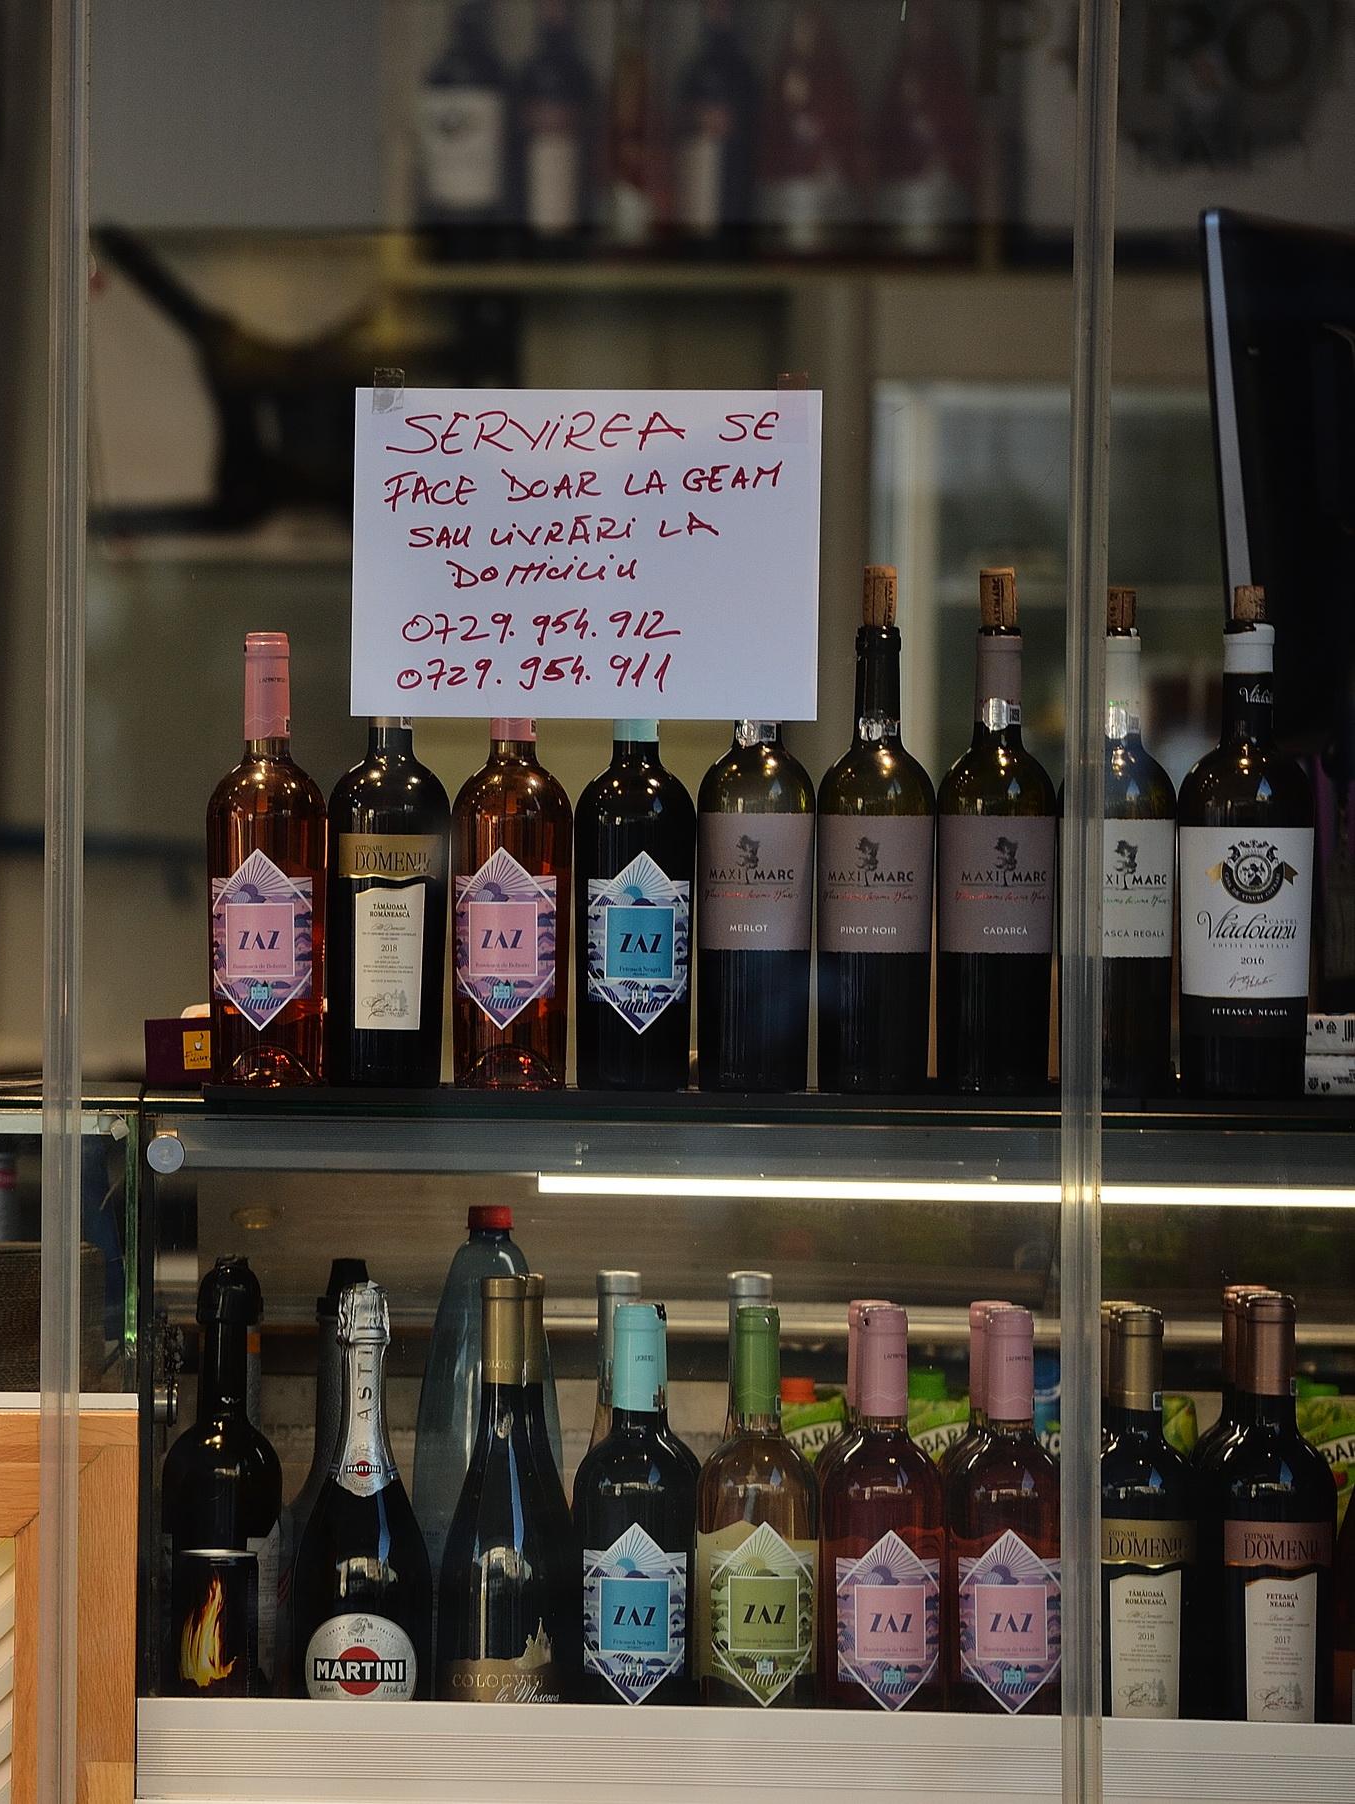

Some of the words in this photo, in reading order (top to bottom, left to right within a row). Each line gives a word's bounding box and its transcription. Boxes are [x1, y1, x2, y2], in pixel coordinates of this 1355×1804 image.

[719, 411, 780, 442] SE
[384, 470, 478, 513] FACE
[500, 467, 603, 503] DOAR
[623, 469, 668, 496] LA
[682, 460, 784, 494] GEAM
[408, 525, 471, 549] SAU
[657, 512, 720, 538] LA
[709, 868, 742, 880] MAXI
[753, 869, 794, 880] MARC
[827, 871, 861, 882] MAXI
[872, 871, 914, 882] MARC
[961, 870, 999, 882] MAXI
[1011, 871, 1047, 882] MARC
[1105, 873, 1119, 886] XI
[1131, 873, 1167, 886] MARC
[729, 923, 769, 933] MERLOT
[840, 926, 868, 935] PINOT
[871, 926, 897, 935] NOIR
[1104, 928, 1130, 938] ASCĂ
[238, 930, 281, 951] ZAZ
[380, 944, 398, 952] 2018
[481, 929, 524, 949] ZAZ
[619, 932, 663, 954] ZAZ
[1240, 956, 1265, 966] 2016
[357, 1349, 373, 1422] ASTI
[920, 1425, 966, 1453] BAR
[346, 1465, 381, 1474] MARTINI
[612, 1605, 657, 1627] ZAZ
[743, 1604, 787, 1625] ZAZ
[869, 1612, 913, 1633] ZAZ
[989, 1612, 1033, 1633] ZAZ
[316, 1660, 404, 1681] MARTINI
